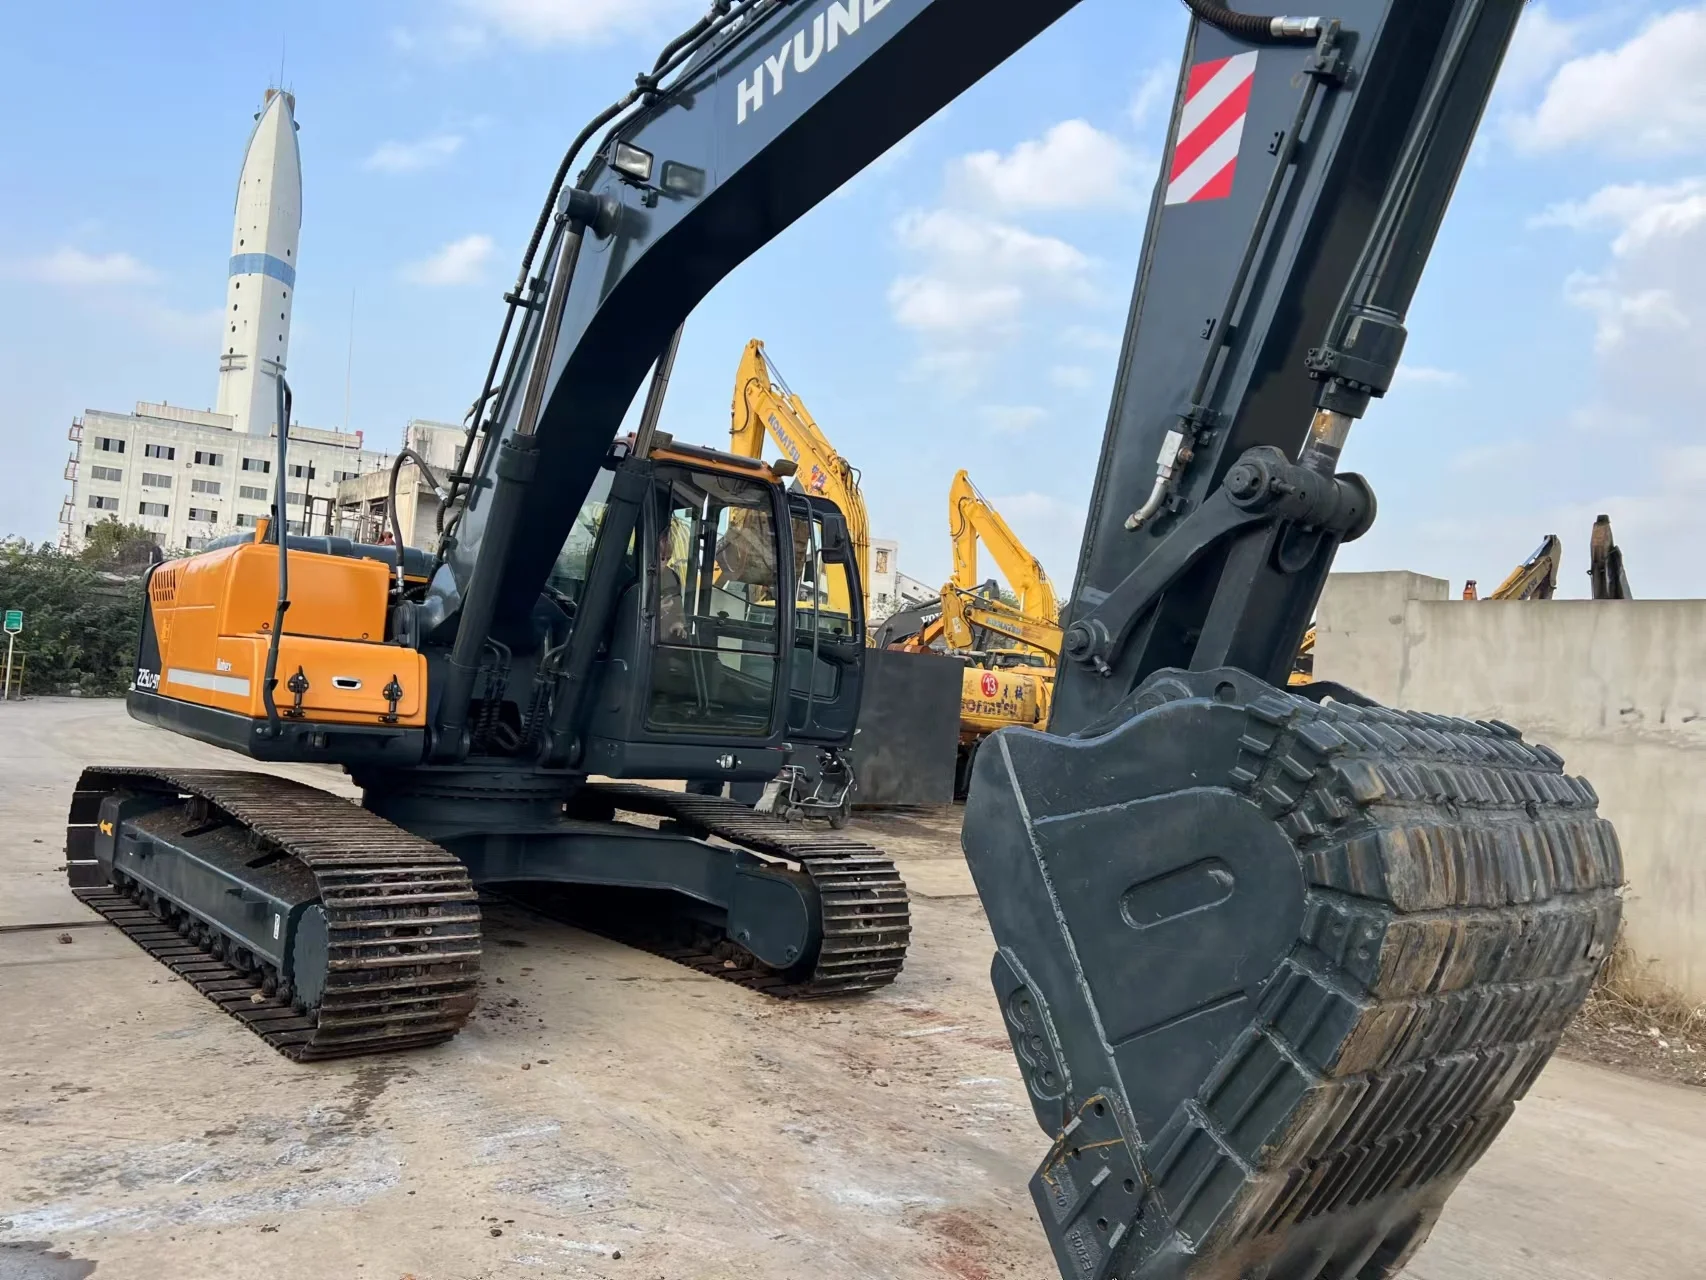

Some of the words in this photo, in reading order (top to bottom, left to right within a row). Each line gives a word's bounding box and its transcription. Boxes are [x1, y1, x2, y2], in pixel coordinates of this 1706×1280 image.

[737, 0, 891, 124] HYUN
[768, 413, 800, 463] KOMATSU
[985, 677, 996, 692] 13
